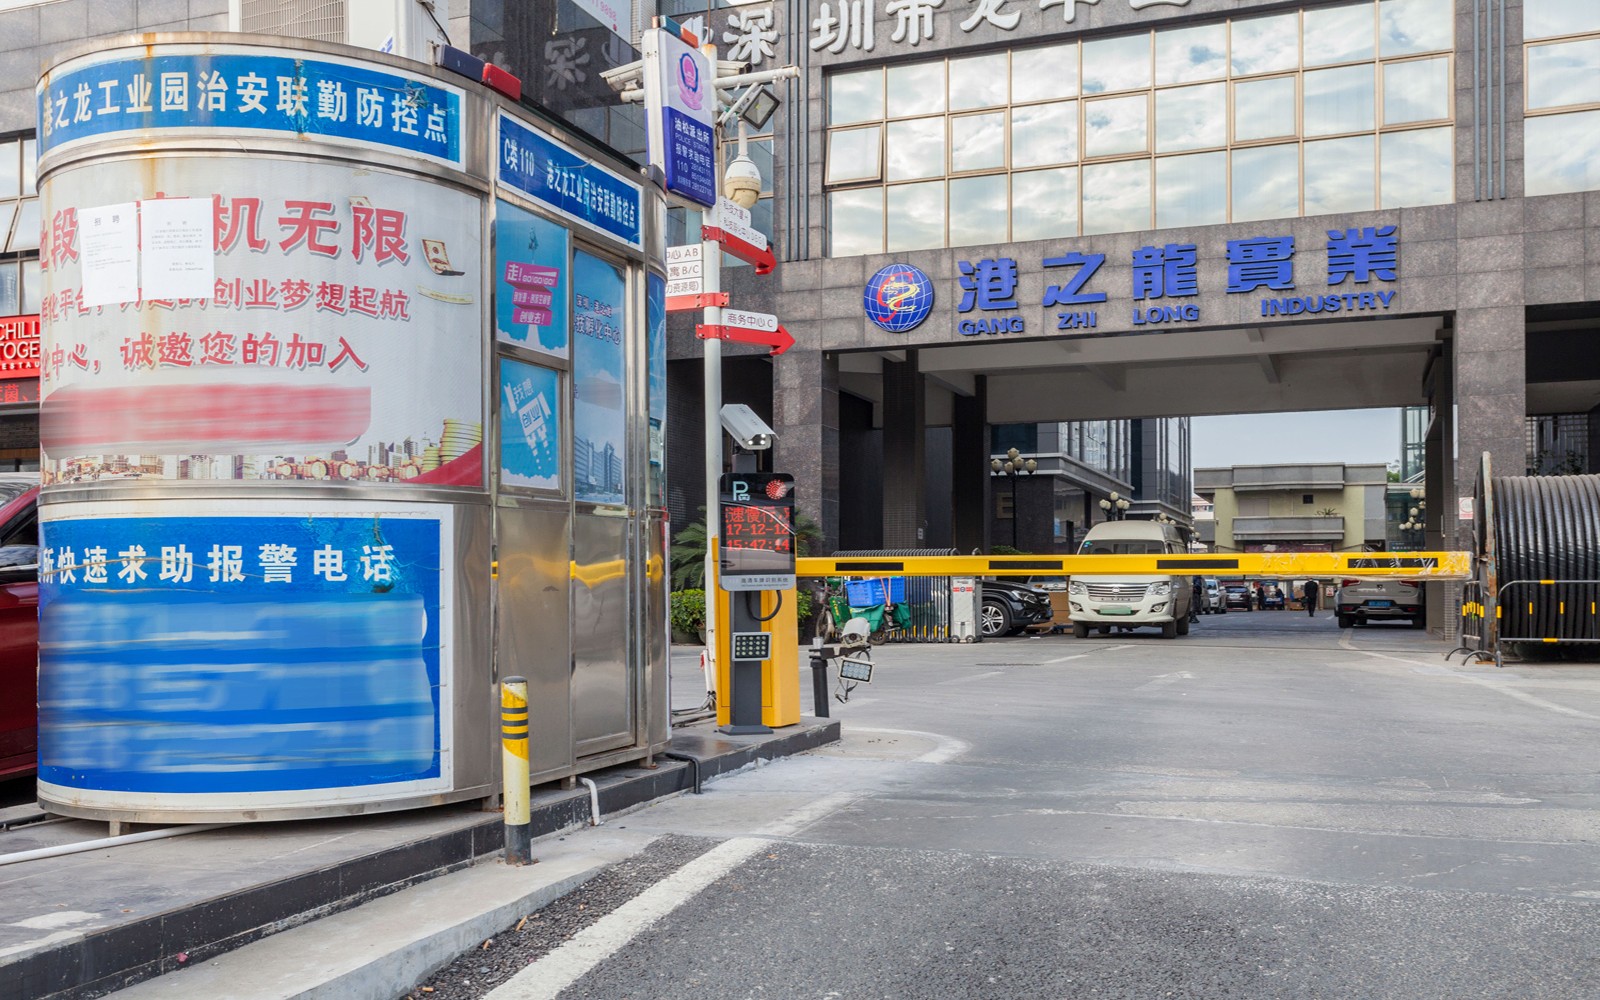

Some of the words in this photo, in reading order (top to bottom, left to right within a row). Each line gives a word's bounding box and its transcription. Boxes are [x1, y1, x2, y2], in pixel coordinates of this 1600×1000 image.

[676, 160, 689, 173] 110
[958, 225, 1398, 312] 港之龍實業
[574, 313, 621, 345] 技孵化中心
[958, 316, 1024, 336] GANG
[1058, 312, 1098, 330] ZHI
[1133, 304, 1200, 325] LONG
[1261, 290, 1397, 317] INDUSTRY
[726, 524, 790, 536] 17-12-12
[726, 539, 790, 551] 15:47:14
[38, 544, 395, 584] 所快速求助报警电话
